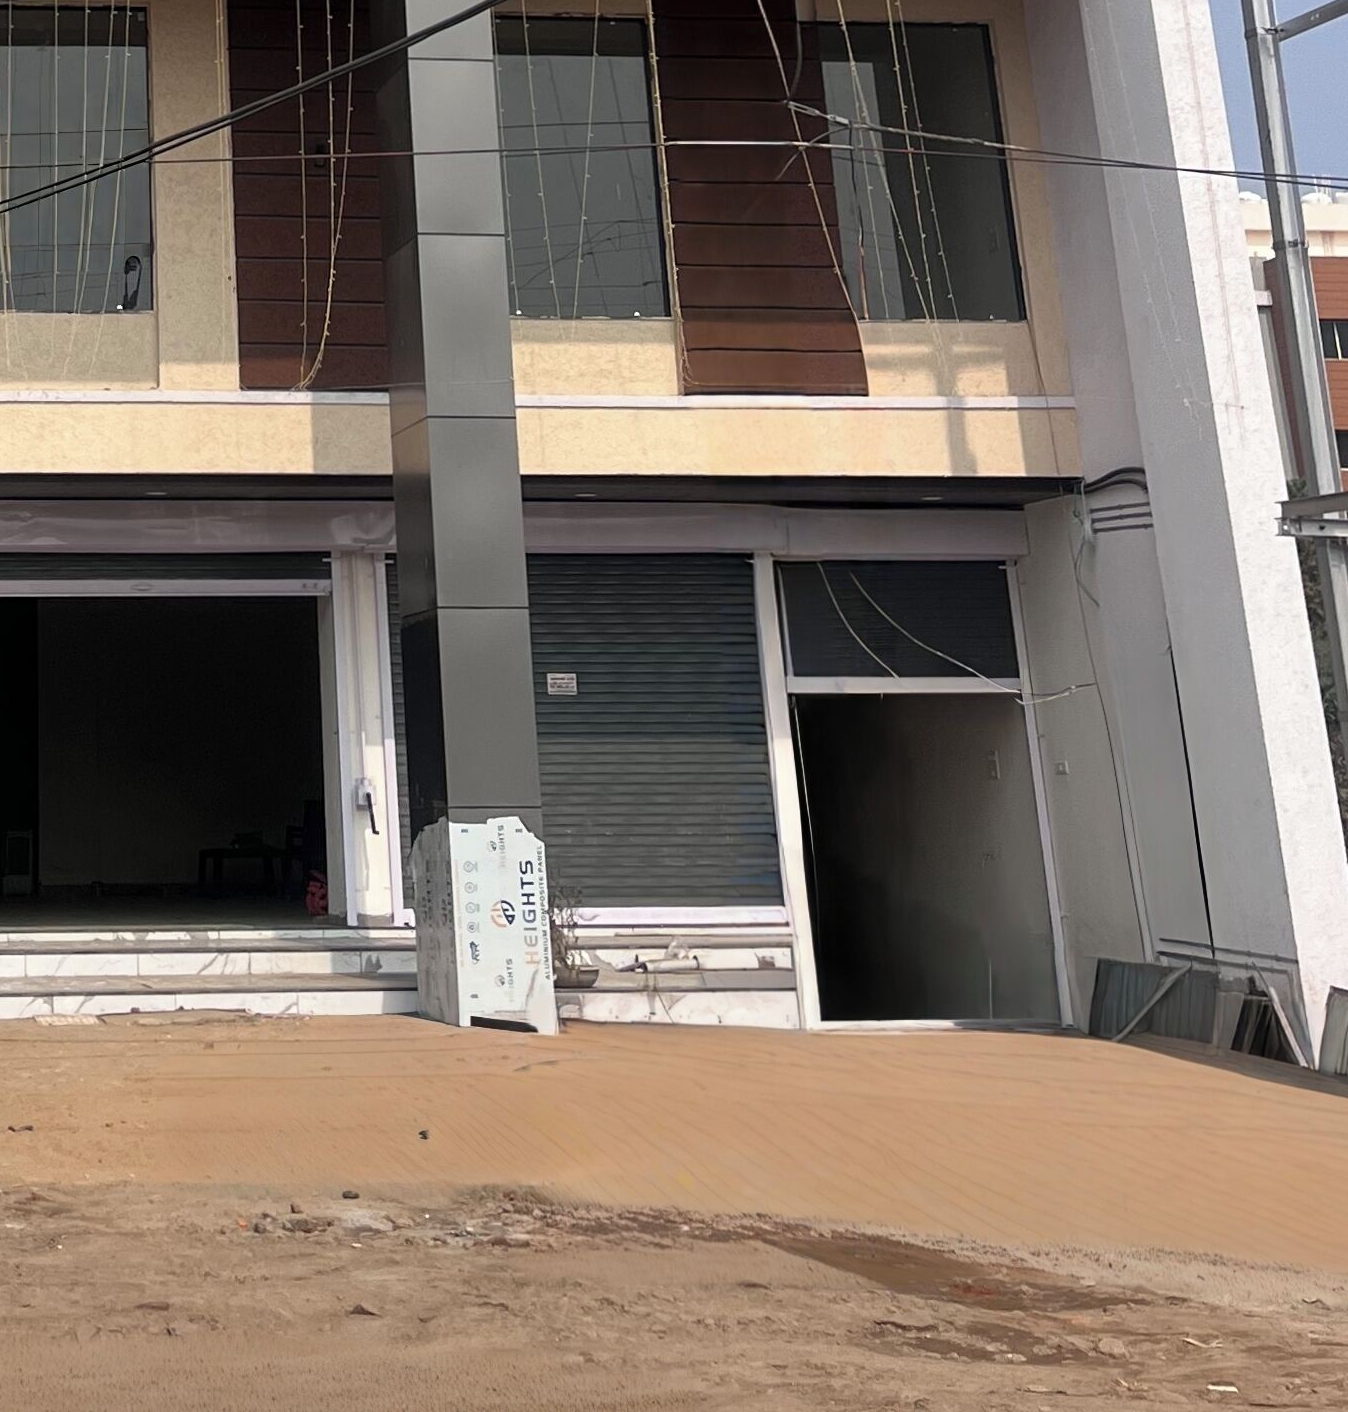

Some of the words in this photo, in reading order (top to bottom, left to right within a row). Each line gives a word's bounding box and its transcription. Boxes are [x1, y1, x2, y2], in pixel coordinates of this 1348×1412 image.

[536, 844, 545, 873] PANEL
[519, 859, 540, 966] HEIGHTS
[543, 929, 551, 981] ALUMINIUM
